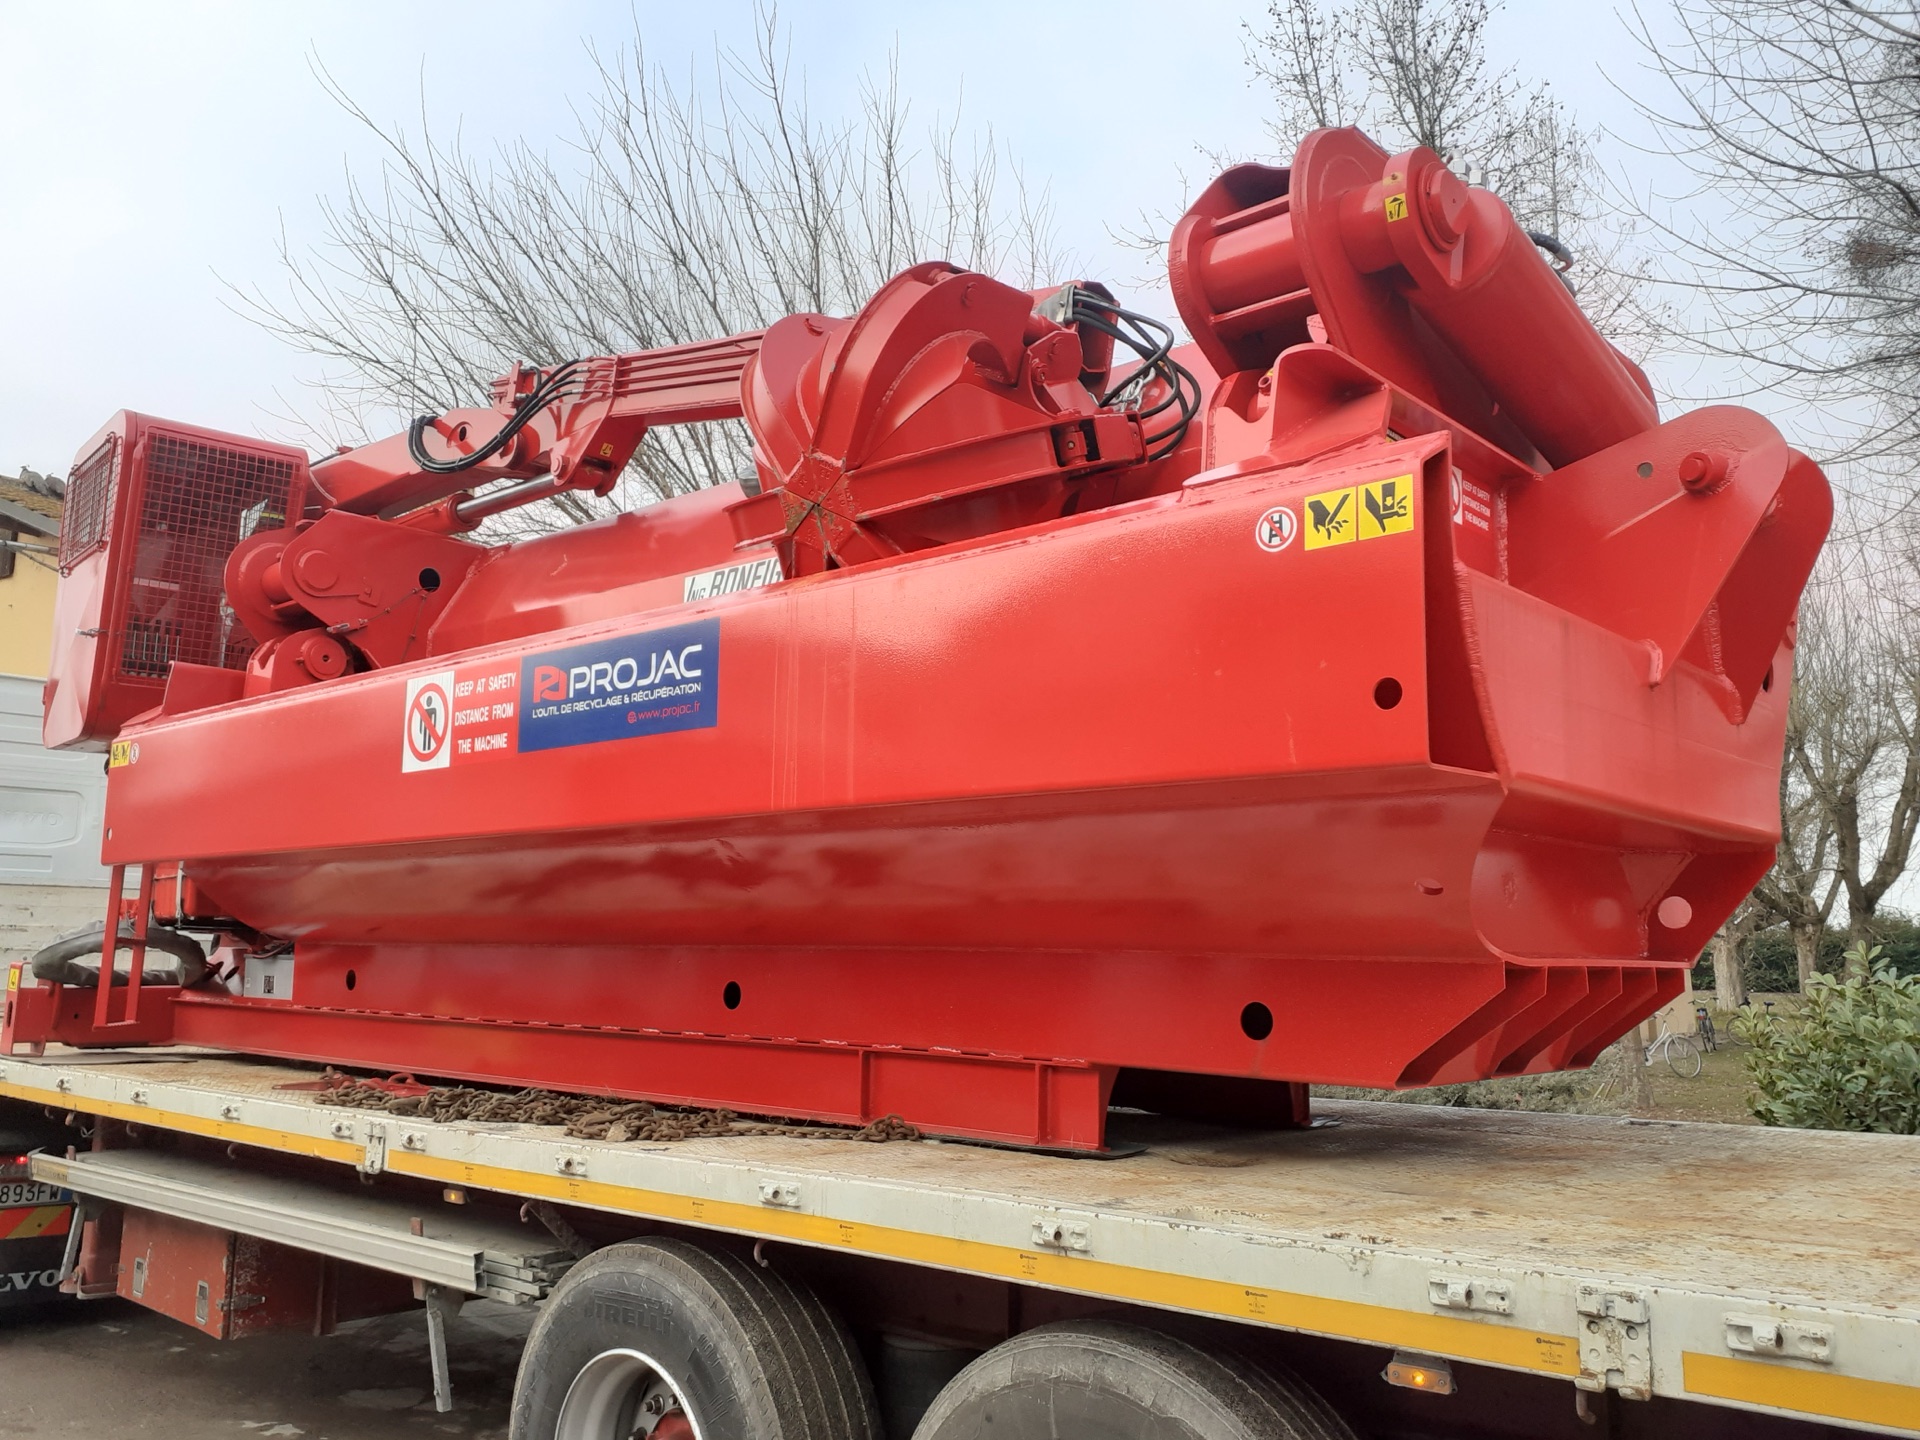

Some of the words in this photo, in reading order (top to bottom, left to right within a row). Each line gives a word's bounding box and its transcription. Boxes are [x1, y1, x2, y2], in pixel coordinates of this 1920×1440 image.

[568, 643, 703, 699] PROJAC
[455, 680, 474, 698] KEEP
[476, 678, 486, 694] AT
[488, 672, 517, 692] SAFETY
[532, 703, 560, 719] L'OUTIL
[561, 703, 572, 714] DE
[573, 695, 622, 713] RECYCLAGE
[623, 694, 630, 704] &
[631, 681, 702, 703] RÉCUPÉRATION
[638, 701, 701, 720] www.projac.fr
[454, 706, 489, 727] DISTANCE
[492, 702, 514, 720] FROM
[457, 738, 472, 754] THE
[474, 732, 508, 752] MACHINE
